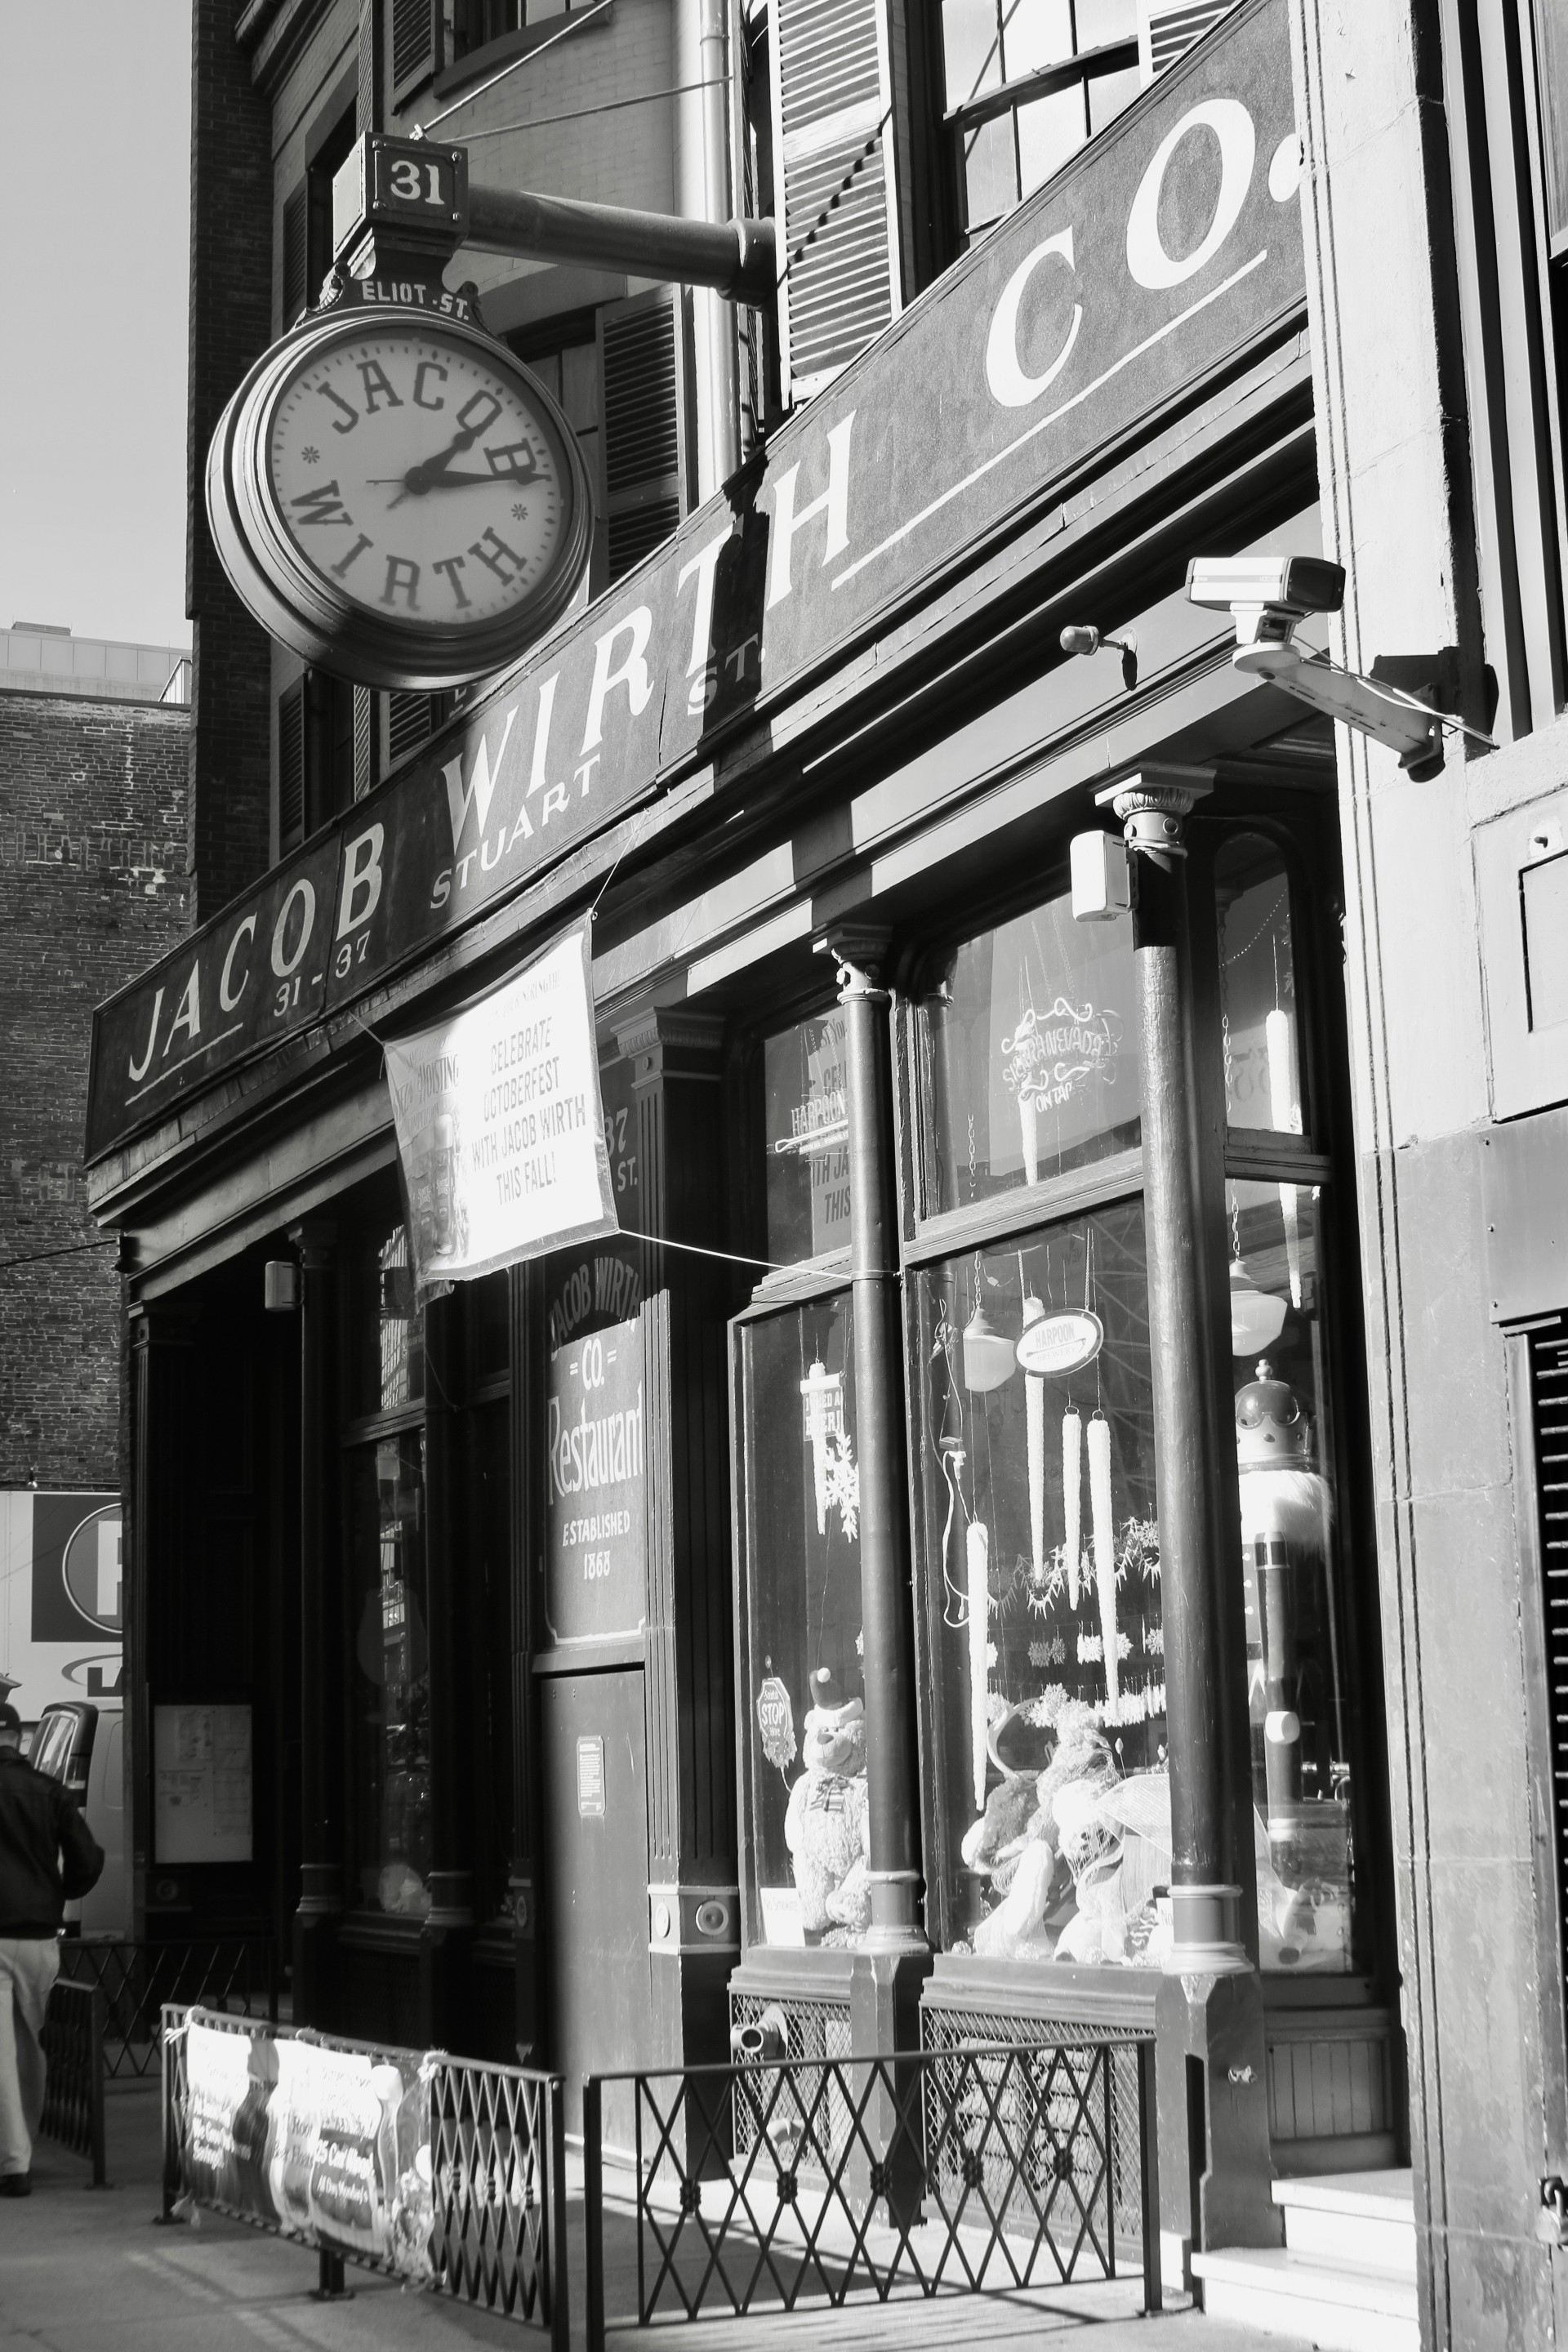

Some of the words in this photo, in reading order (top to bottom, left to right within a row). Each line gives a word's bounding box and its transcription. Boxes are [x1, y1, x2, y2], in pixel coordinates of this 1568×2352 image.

[390, 160, 445, 206] 31
[362, 281, 426, 304] ELIOT
[318, 359, 539, 487] JACOB
[290, 479, 528, 612] WIRTH
[128, 822, 384, 1081] JACOB
[441, 408, 858, 856] WIRTH
[985, 98, 1302, 408] CO.
[430, 753, 601, 910] STUART
[688, 633, 765, 716] ST.
[491, 1016, 553, 1076] CELEBRATE
[483, 1056, 559, 1123] OCTOBERFEST
[1036, 1091, 1053, 1113] ON
[1052, 1081, 1072, 1105] TAP
[471, 1135, 498, 1173] WITH
[501, 1113, 537, 1160] JACOB
[540, 1094, 586, 1141] WIRTH
[496, 1167, 522, 1206] THIS
[524, 1151, 558, 1194] FALL!
[824, 1185, 851, 1225] THIS
[549, 1263, 591, 1362] JACOB
[595, 1256, 642, 1333] WIRTH
[1035, 1321, 1076, 1350] HARPOON
[582, 1338, 605, 1391] CO.
[1036, 1347, 1077, 1364] BREWERY
[547, 1379, 644, 1505] Restaurant
[563, 1510, 630, 1547] ESTABLISHED
[584, 1550, 610, 1580] 1868
[761, 1701, 785, 1726] STOP
